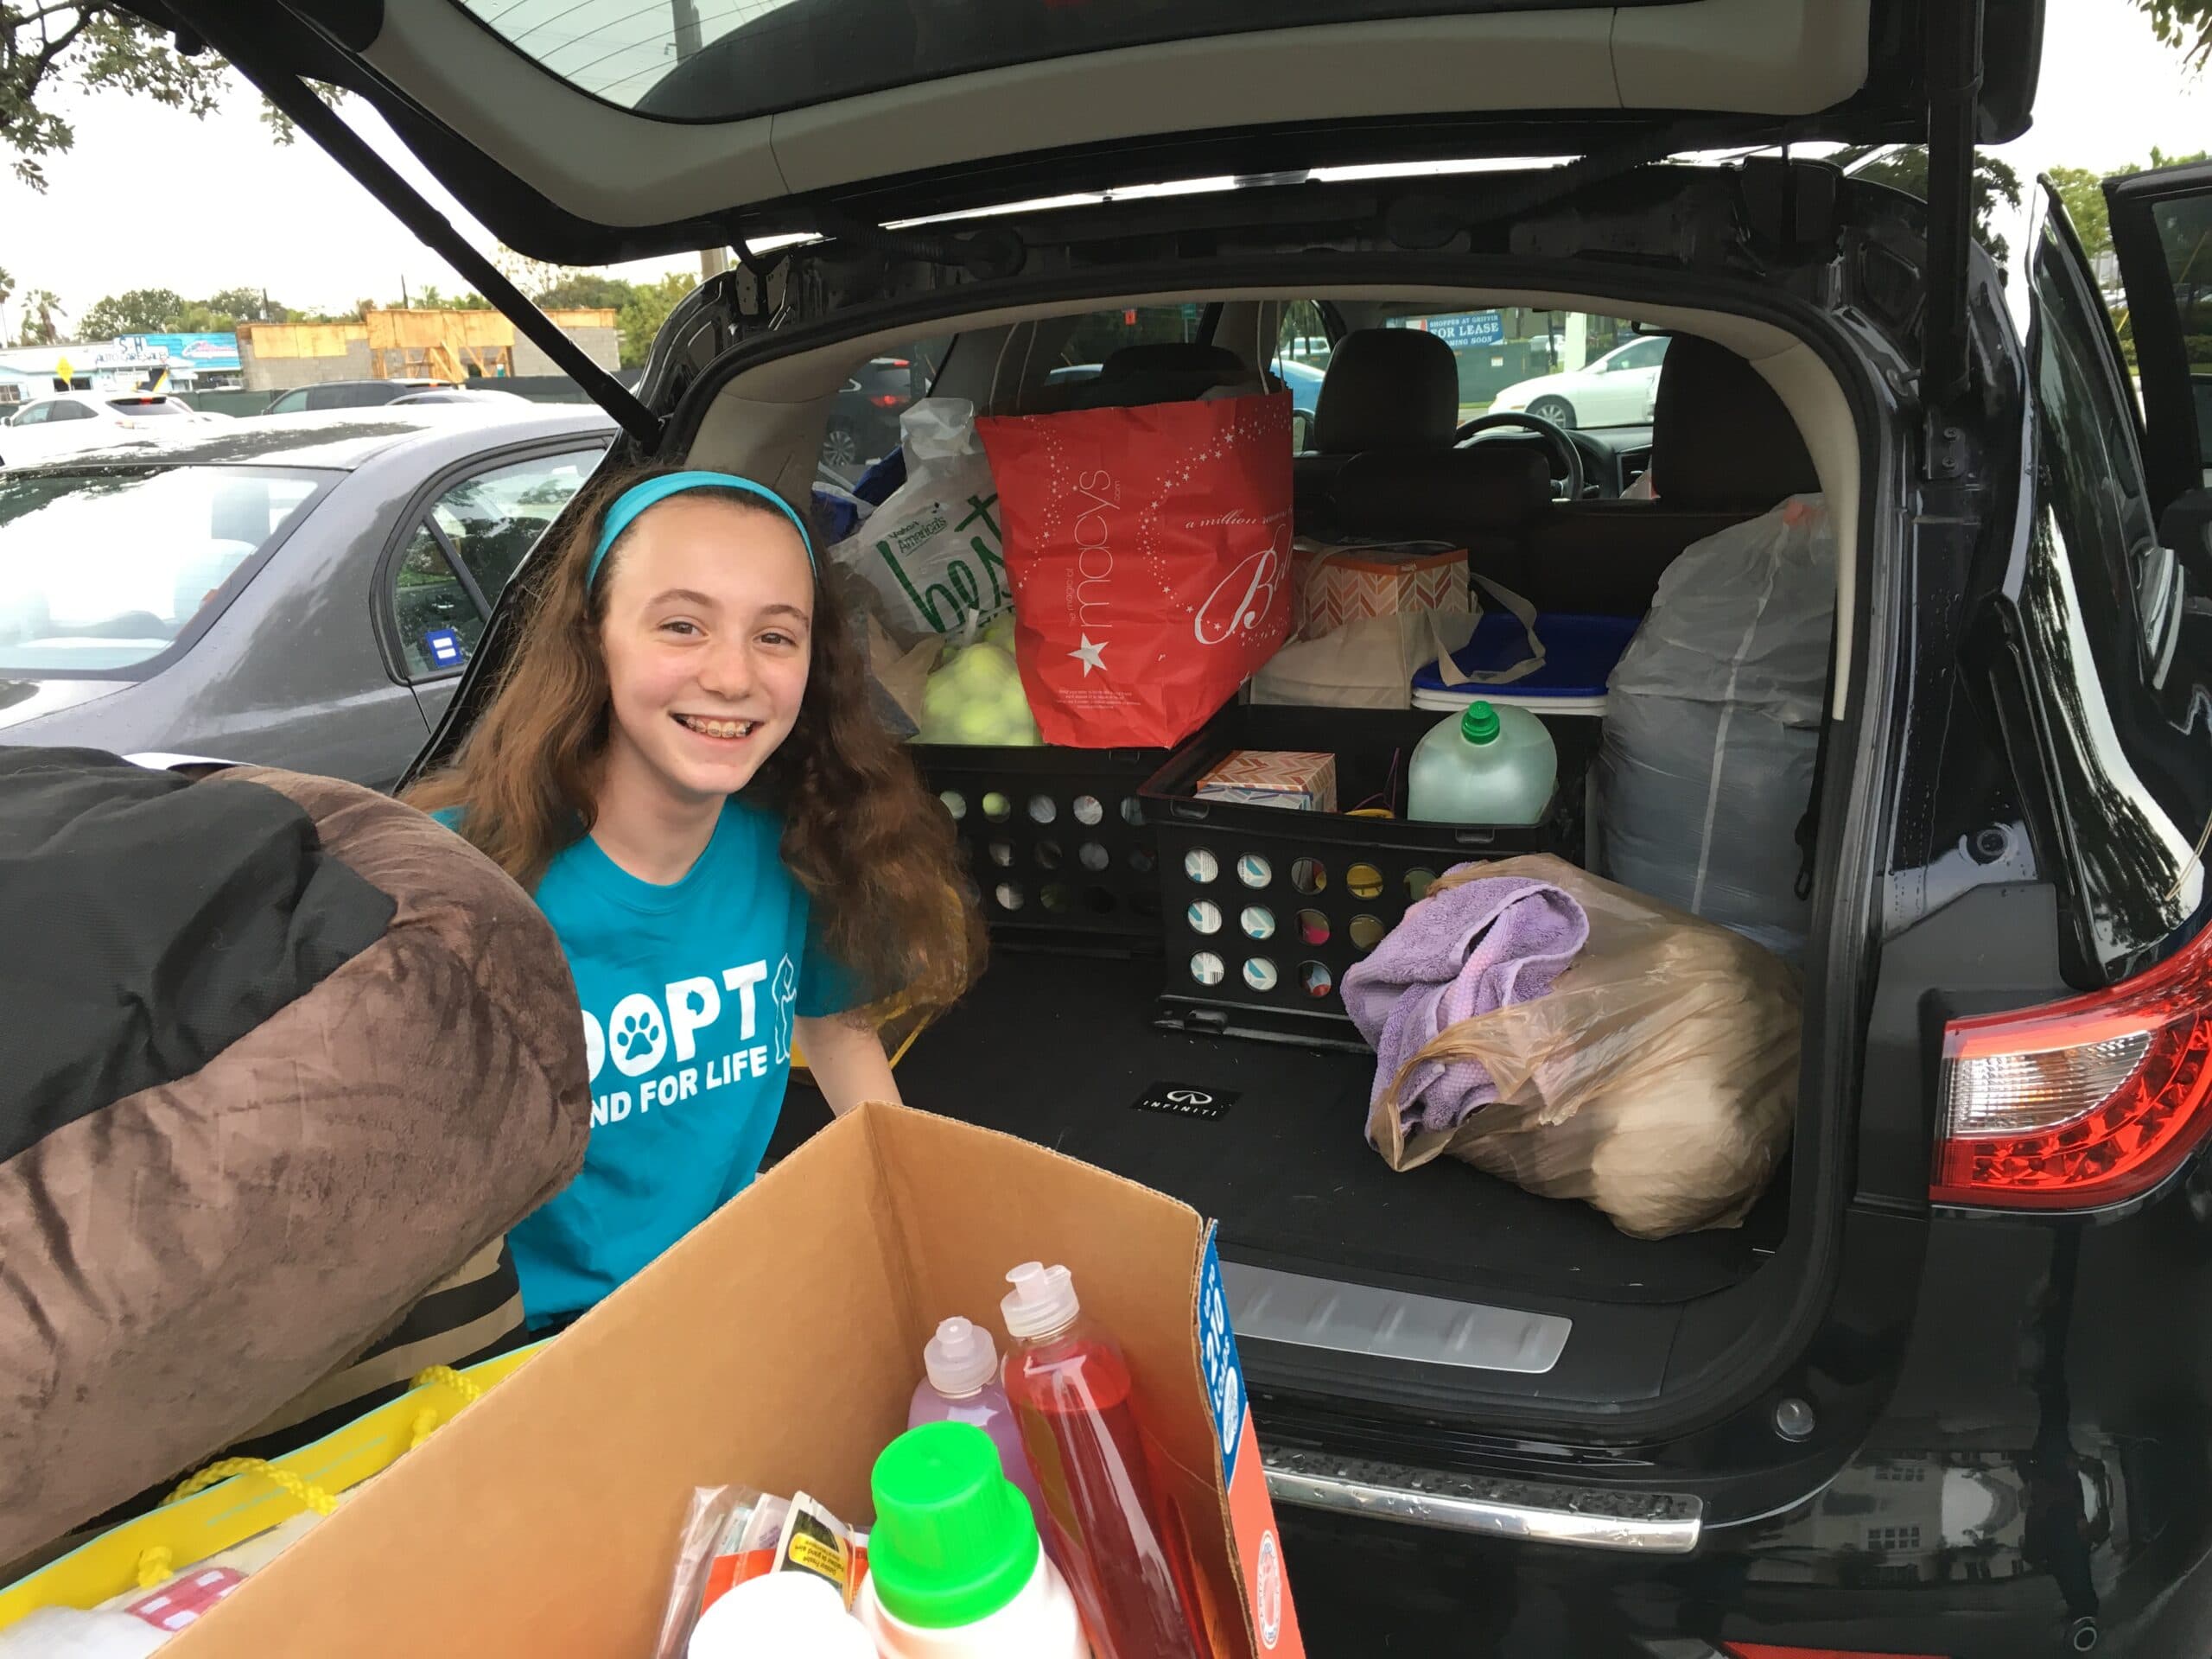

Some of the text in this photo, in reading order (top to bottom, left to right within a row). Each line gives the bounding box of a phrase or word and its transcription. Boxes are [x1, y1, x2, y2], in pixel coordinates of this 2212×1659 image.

[1430, 322, 1499, 338] FOR LEASE
[1446, 335, 1492, 346] MING SOON
[1185, 521, 1195, 530] a
[1199, 507, 1257, 527] million
[639, 1067, 698, 1114] FOR
[706, 1045, 768, 1090] LIFE
[1143, 1100, 1217, 1116] INFINITI
[1206, 1287, 1224, 1386] 210
